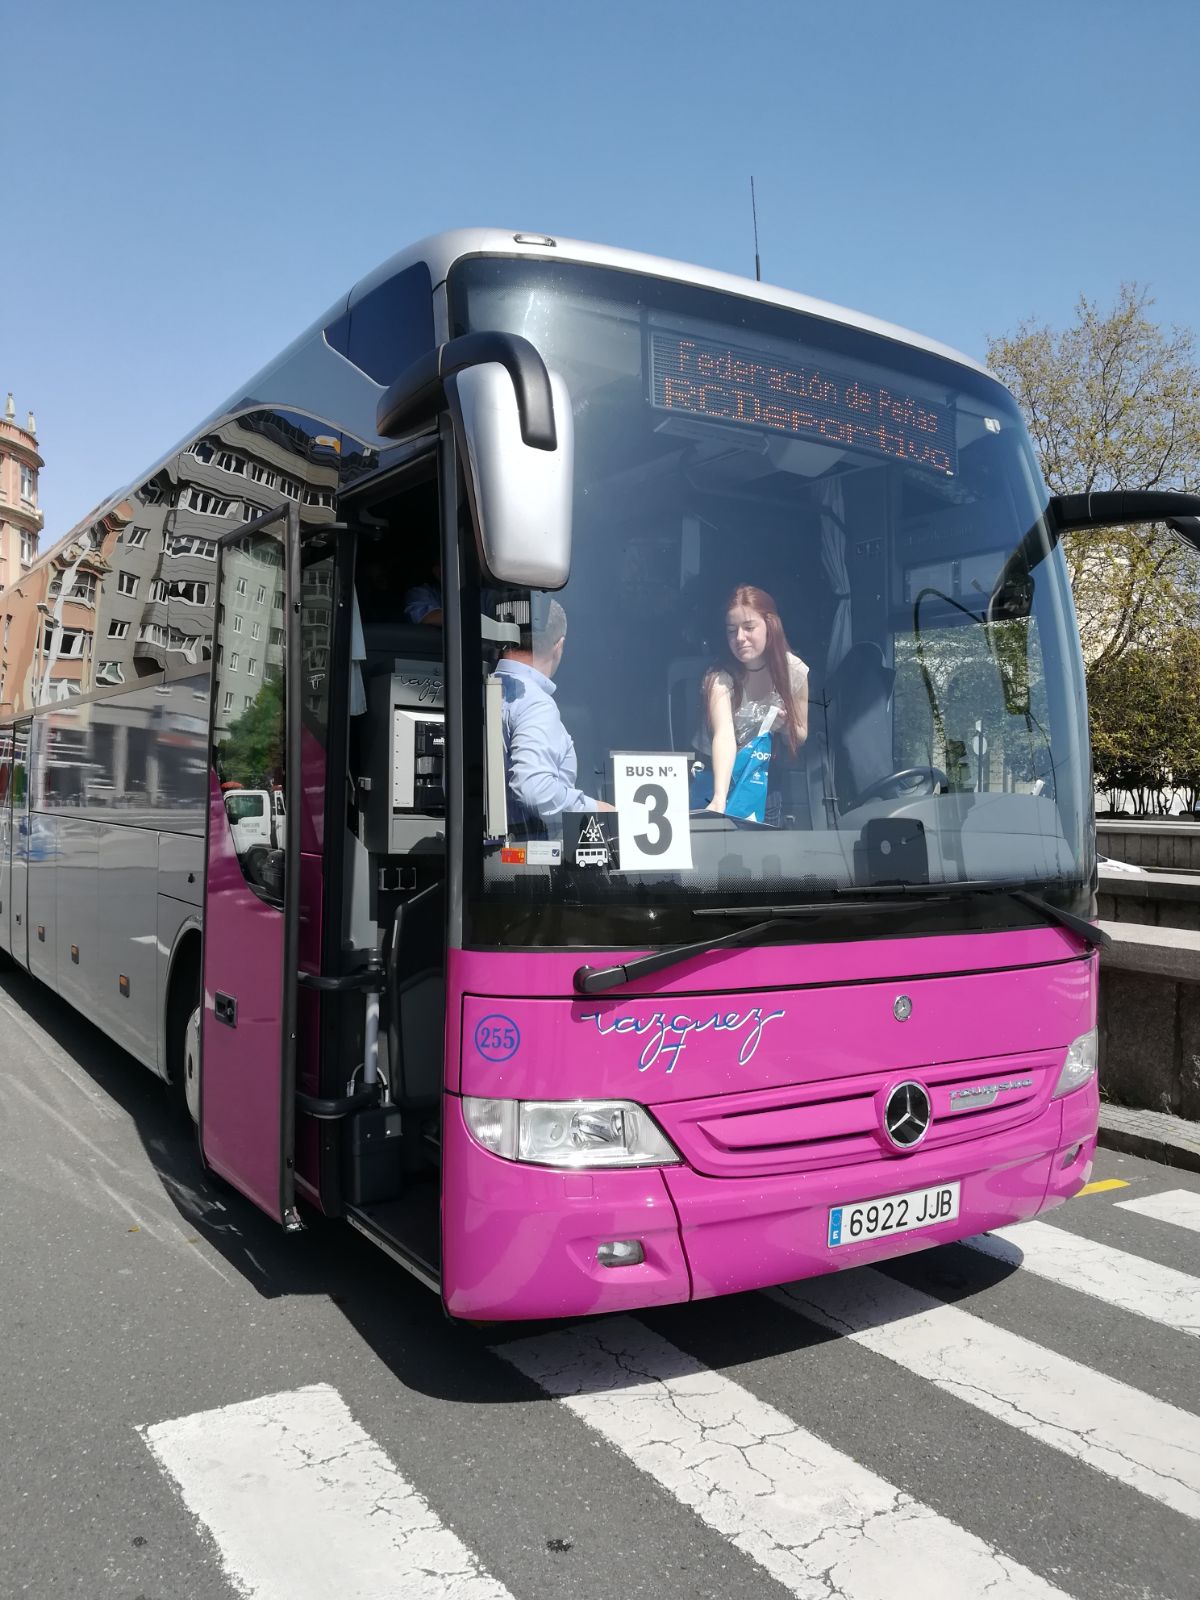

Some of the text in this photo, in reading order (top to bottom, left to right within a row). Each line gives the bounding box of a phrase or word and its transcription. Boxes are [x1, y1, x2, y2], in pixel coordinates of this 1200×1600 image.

[678, 341, 837, 404] Federación
[845, 382, 872, 412] de
[625, 766, 654, 777] BUS
[632, 783, 673, 856] 3
[480, 1027, 515, 1049] 255
[849, 1189, 953, 1237] 6922 JJB
[832, 1230, 840, 1240] E
